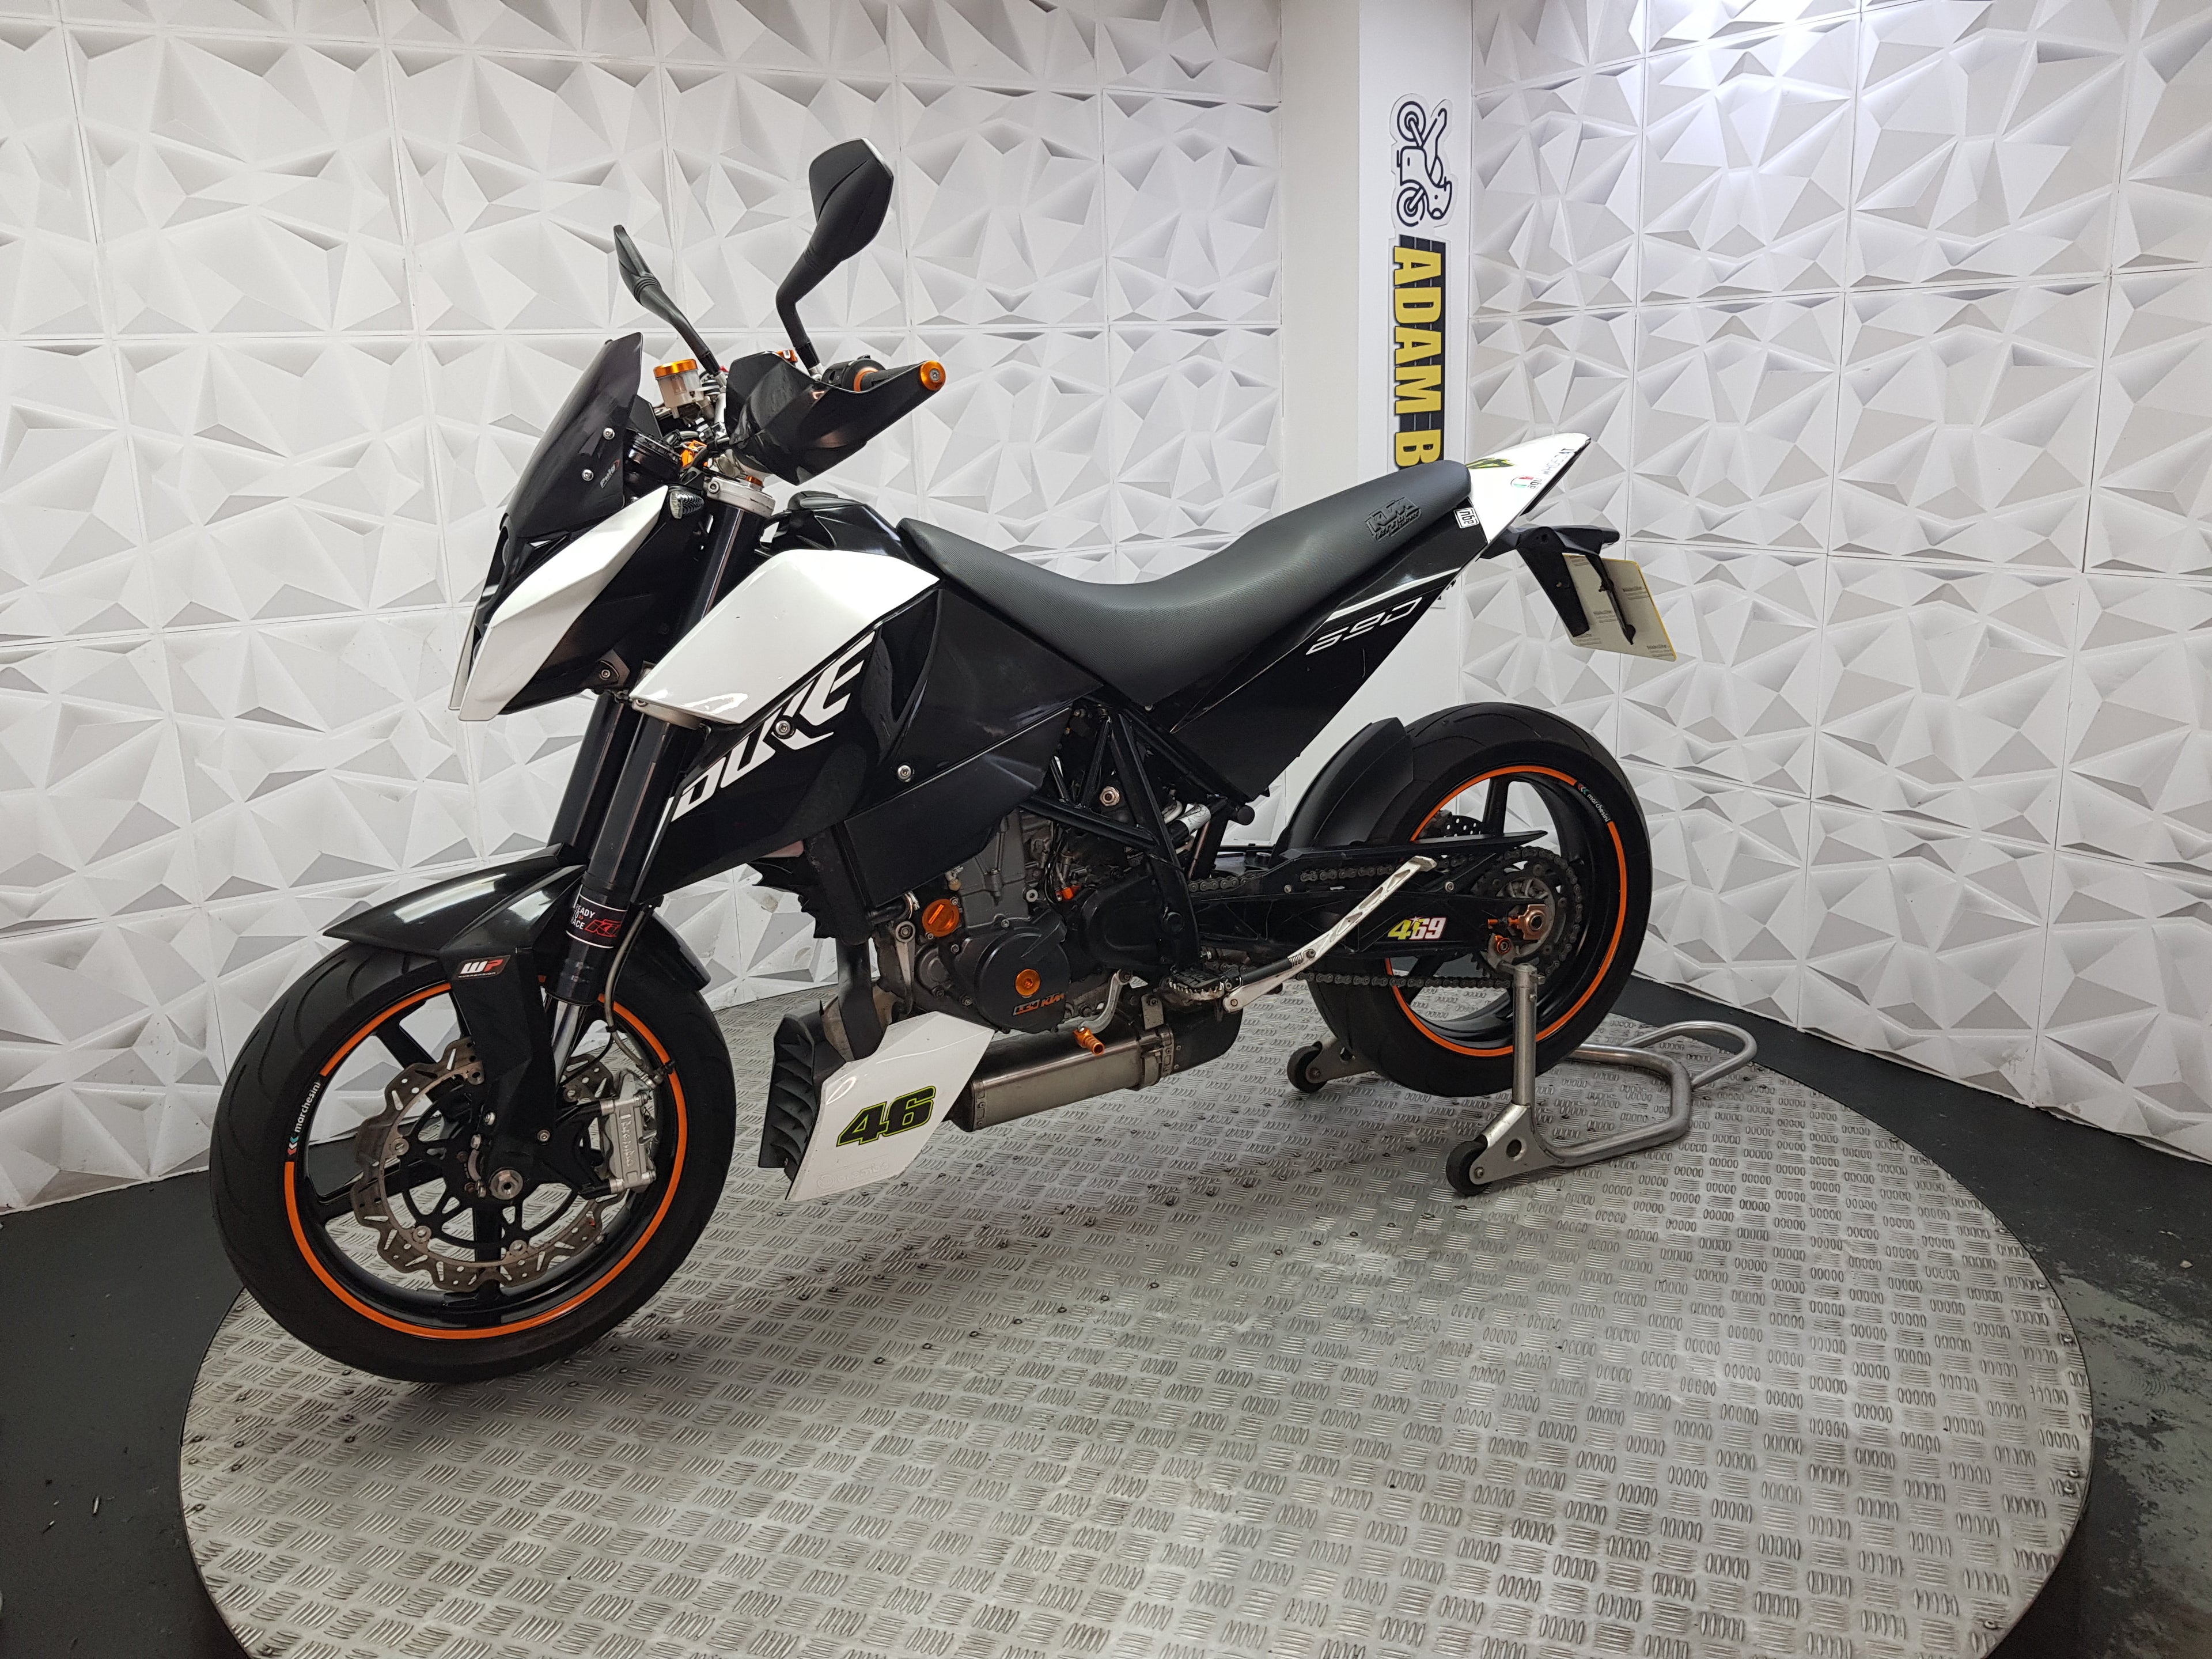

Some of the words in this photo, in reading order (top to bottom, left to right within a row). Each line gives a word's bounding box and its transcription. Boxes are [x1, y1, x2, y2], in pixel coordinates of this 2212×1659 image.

[1393, 245, 1442, 415] ADAM
[599, 463, 616, 488] Puig
[671, 631, 875, 823] DUKE
[575, 903, 596, 919] READY
[460, 959, 503, 974] WP
[294, 1081, 321, 1133] marchesini
[836, 1085, 937, 1147] 46
